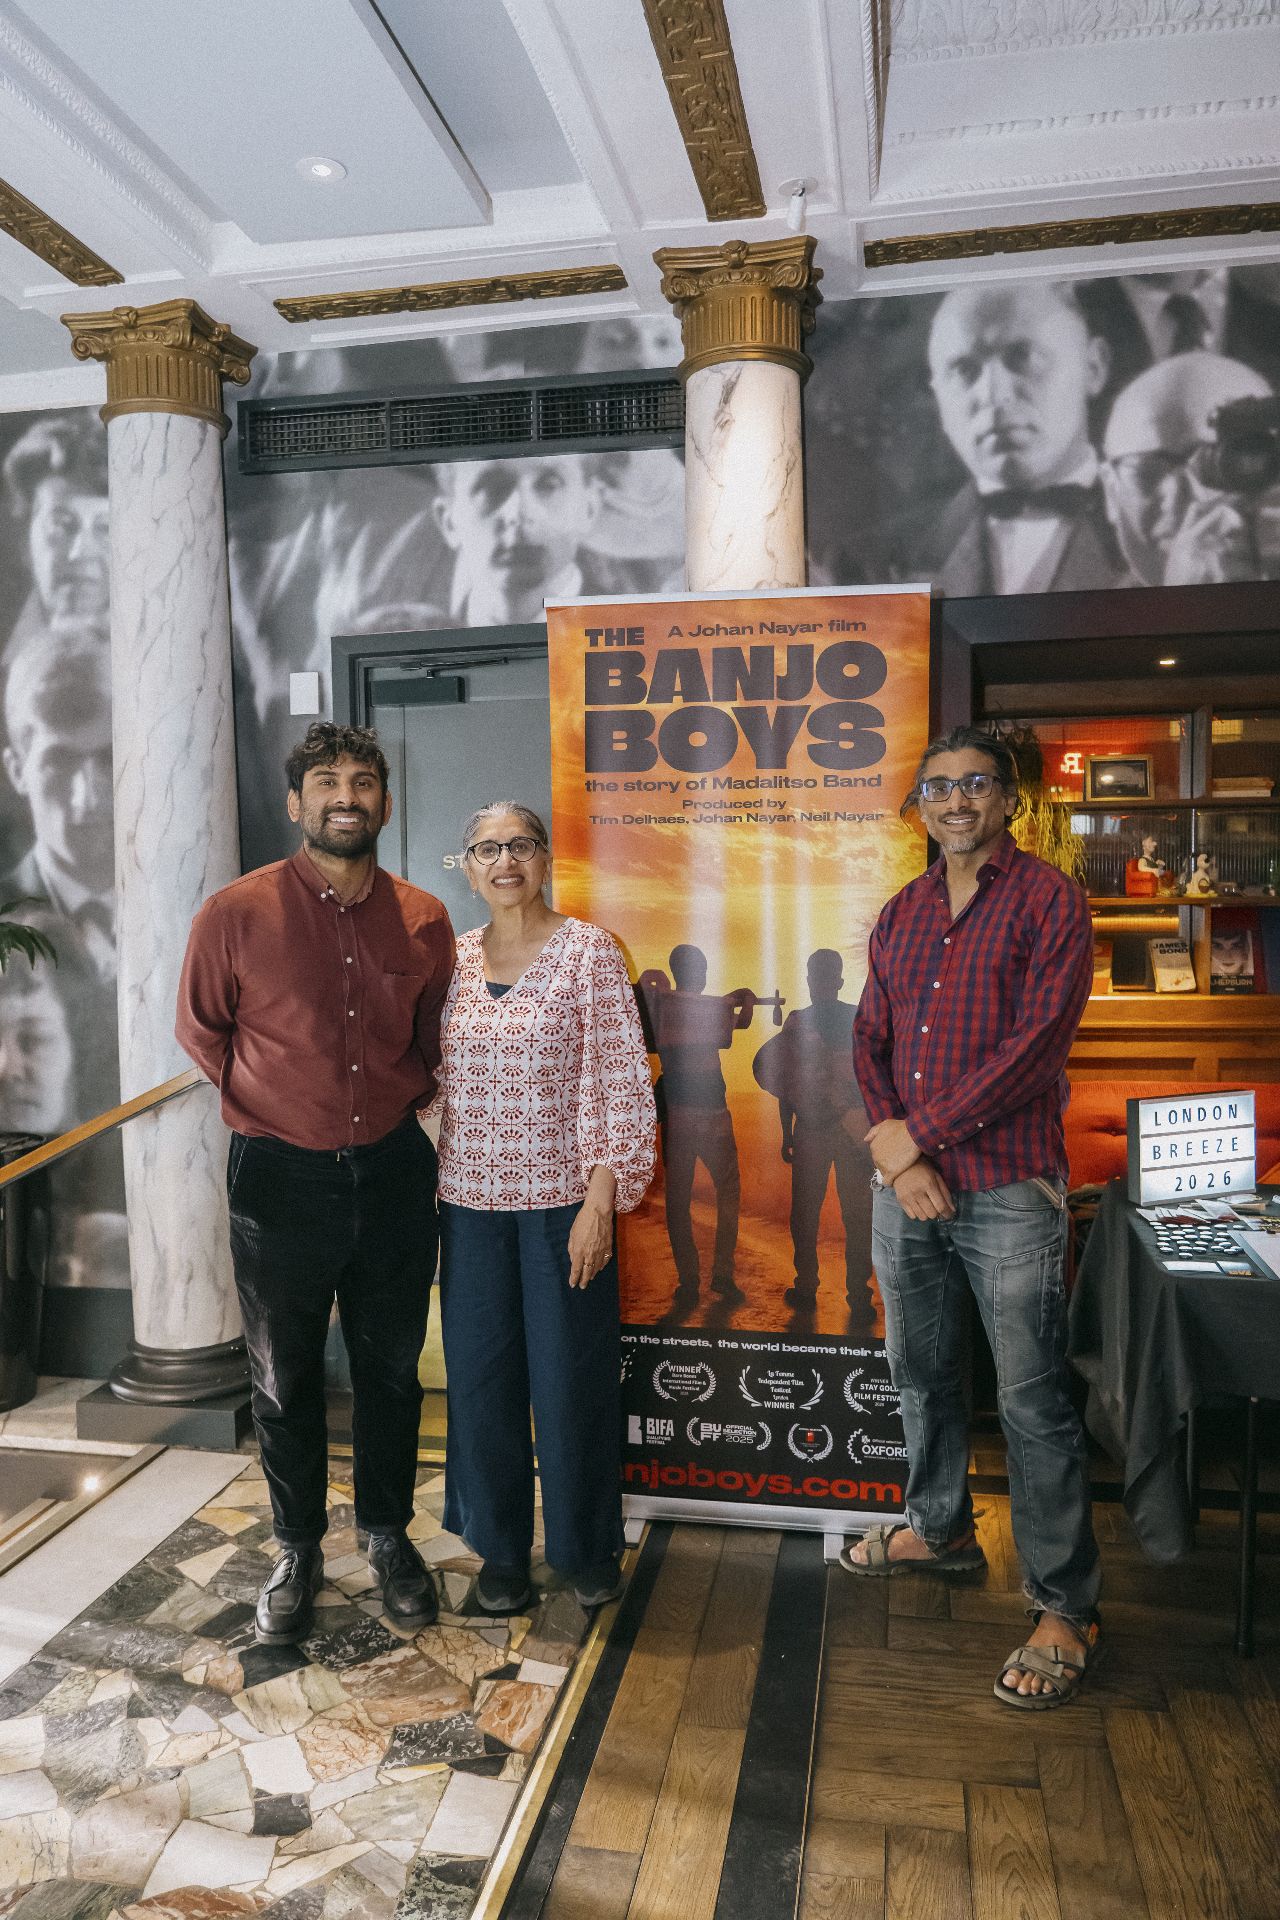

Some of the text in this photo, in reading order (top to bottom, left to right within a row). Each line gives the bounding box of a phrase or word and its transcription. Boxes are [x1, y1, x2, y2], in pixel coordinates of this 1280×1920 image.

[585, 627, 645, 648] THE
[668, 620, 867, 638] A Johan Nayar film
[584, 641, 888, 706] BANJO
[584, 701, 887, 774] BOYS
[585, 774, 882, 793] the story of Madalitso Band
[682, 799, 787, 810] Produced by
[589, 811, 884, 825] Tim Delhaes, Johan Nayar, Neil Nayar
[1154, 1103, 1238, 1126] LONDON
[1152, 1137, 1239, 1160] BREEZE
[1175, 1170, 1231, 1192] 2026
[620, 1335, 637, 1343] on
[639, 1335, 660, 1344] the
[662, 1337, 712, 1348] streets,
[718, 1339, 739, 1349] the
[741, 1341, 780, 1352] world
[782, 1343, 837, 1355] became
[840, 1346, 872, 1358] their
[668, 1365, 701, 1374] WINNER
[860, 1383, 879, 1391] STAY
[763, 1401, 795, 1410] WINNER
[853, 1392, 901, 1402] FILM FESTIVA
[646, 1417, 675, 1437] BIFA
[722, 1428, 757, 1436] SELECTION
[725, 1435, 754, 1444] 2025
[624, 1459, 902, 1503] njoboys.com
